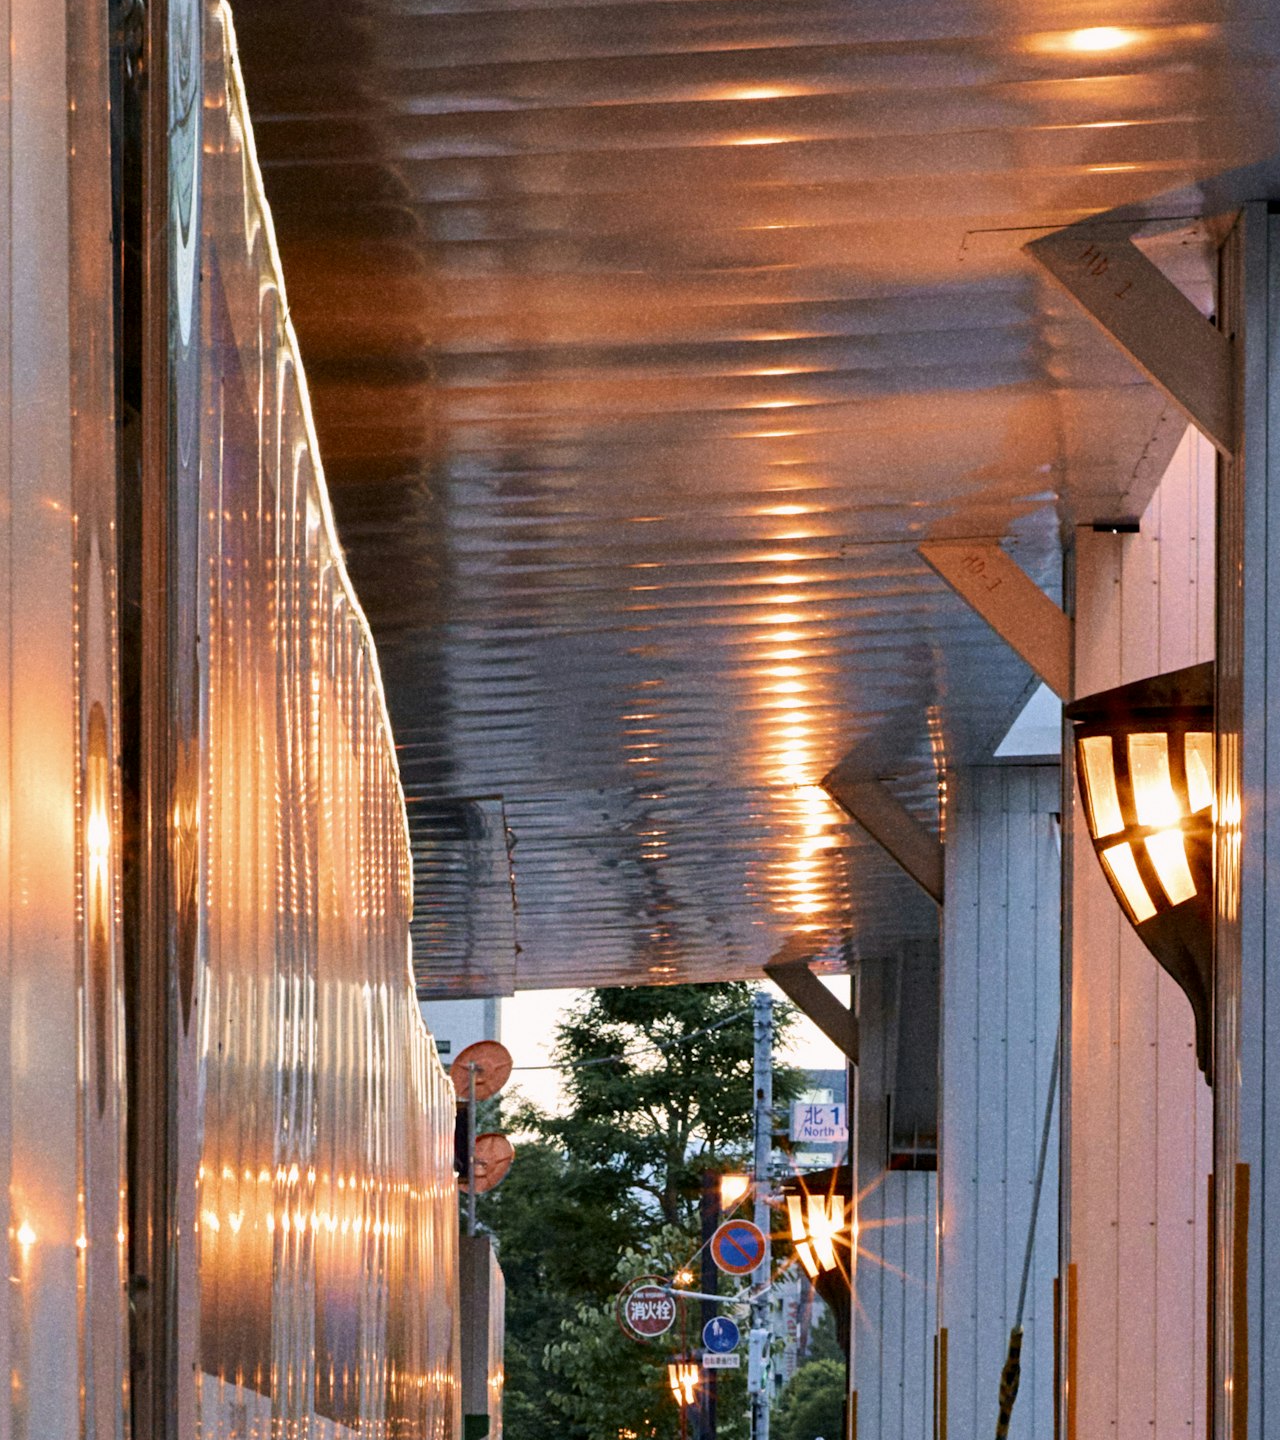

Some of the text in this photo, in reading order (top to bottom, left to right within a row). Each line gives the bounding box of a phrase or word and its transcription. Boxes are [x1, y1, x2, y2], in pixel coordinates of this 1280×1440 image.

[804, 1106, 840, 1126] 北 1
[804, 1126, 835, 1137] North
[631, 1301, 671, 1321] 消火栓
